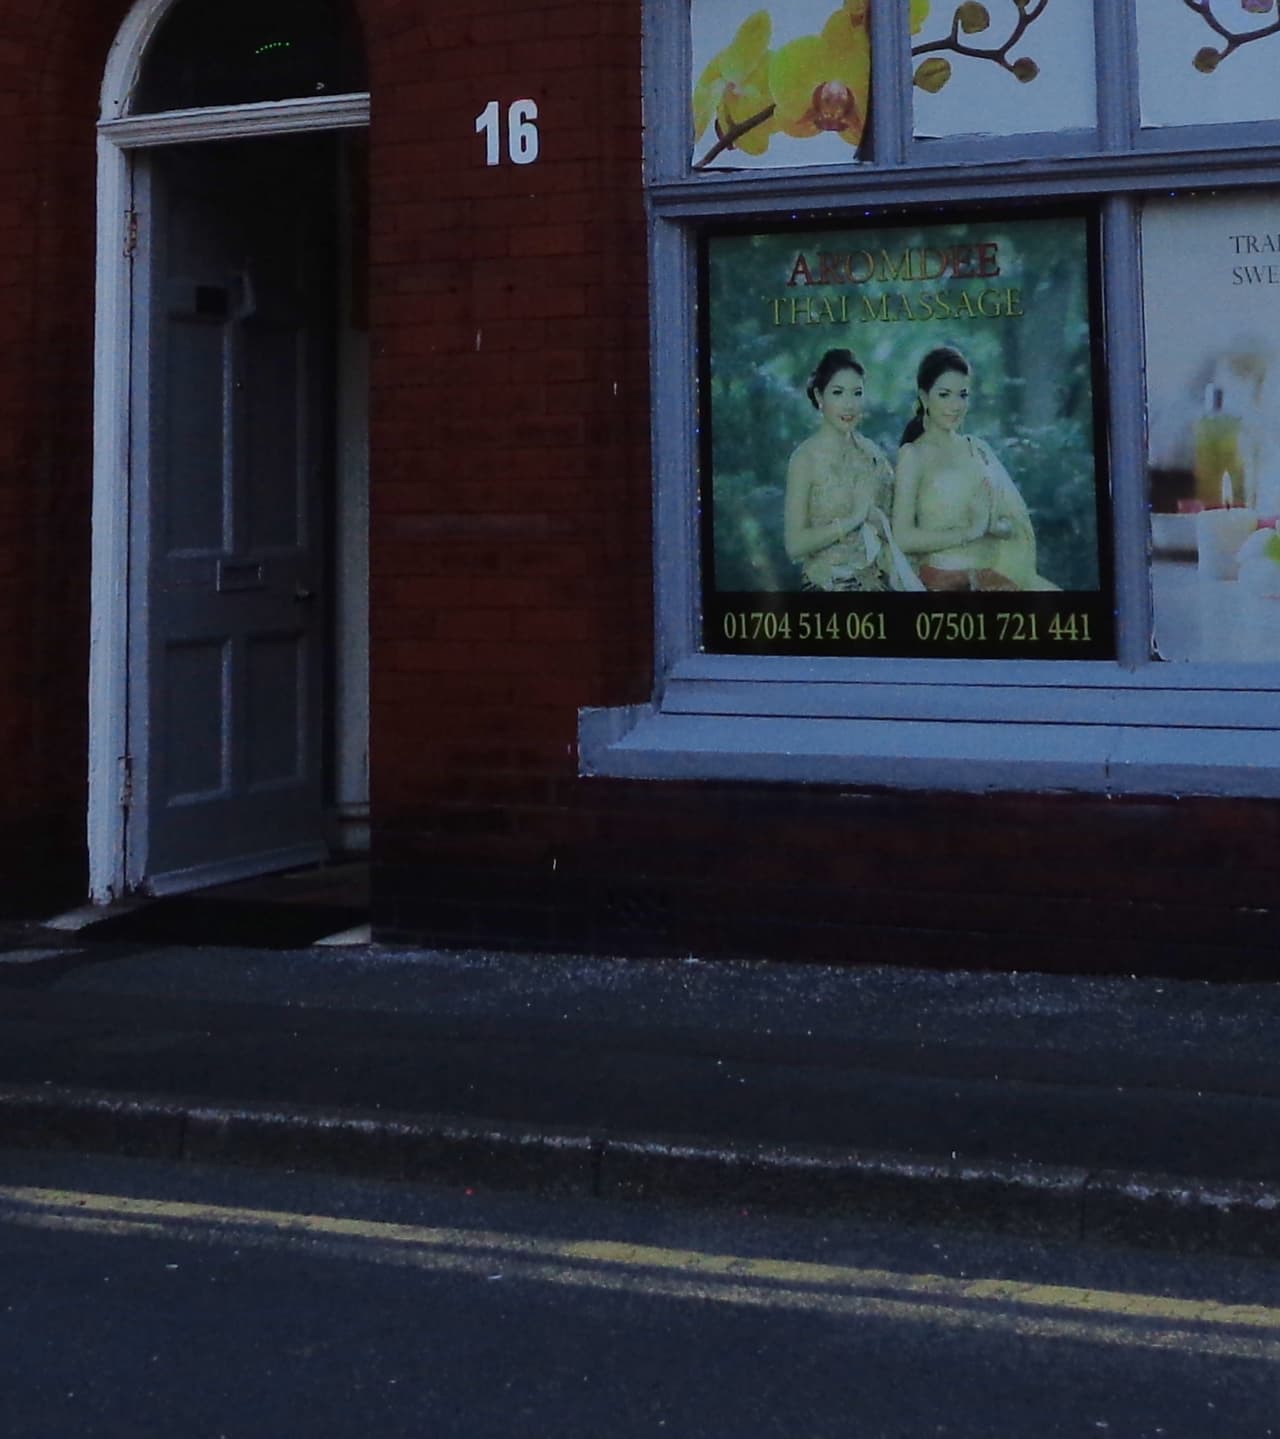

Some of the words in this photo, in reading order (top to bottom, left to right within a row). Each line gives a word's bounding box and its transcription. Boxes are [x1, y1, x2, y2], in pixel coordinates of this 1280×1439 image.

[475, 98, 539, 166] 16
[787, 243, 1001, 286] AROMDEE
[770, 296, 851, 327] THAI
[862, 287, 1024, 323] MASSAGE
[723, 611, 792, 640] 01704
[799, 611, 840, 640] 514
[846, 611, 888, 640] 061
[915, 611, 988, 641] 07501
[996, 612, 1040, 641] 721
[1048, 612, 1093, 641] 441
